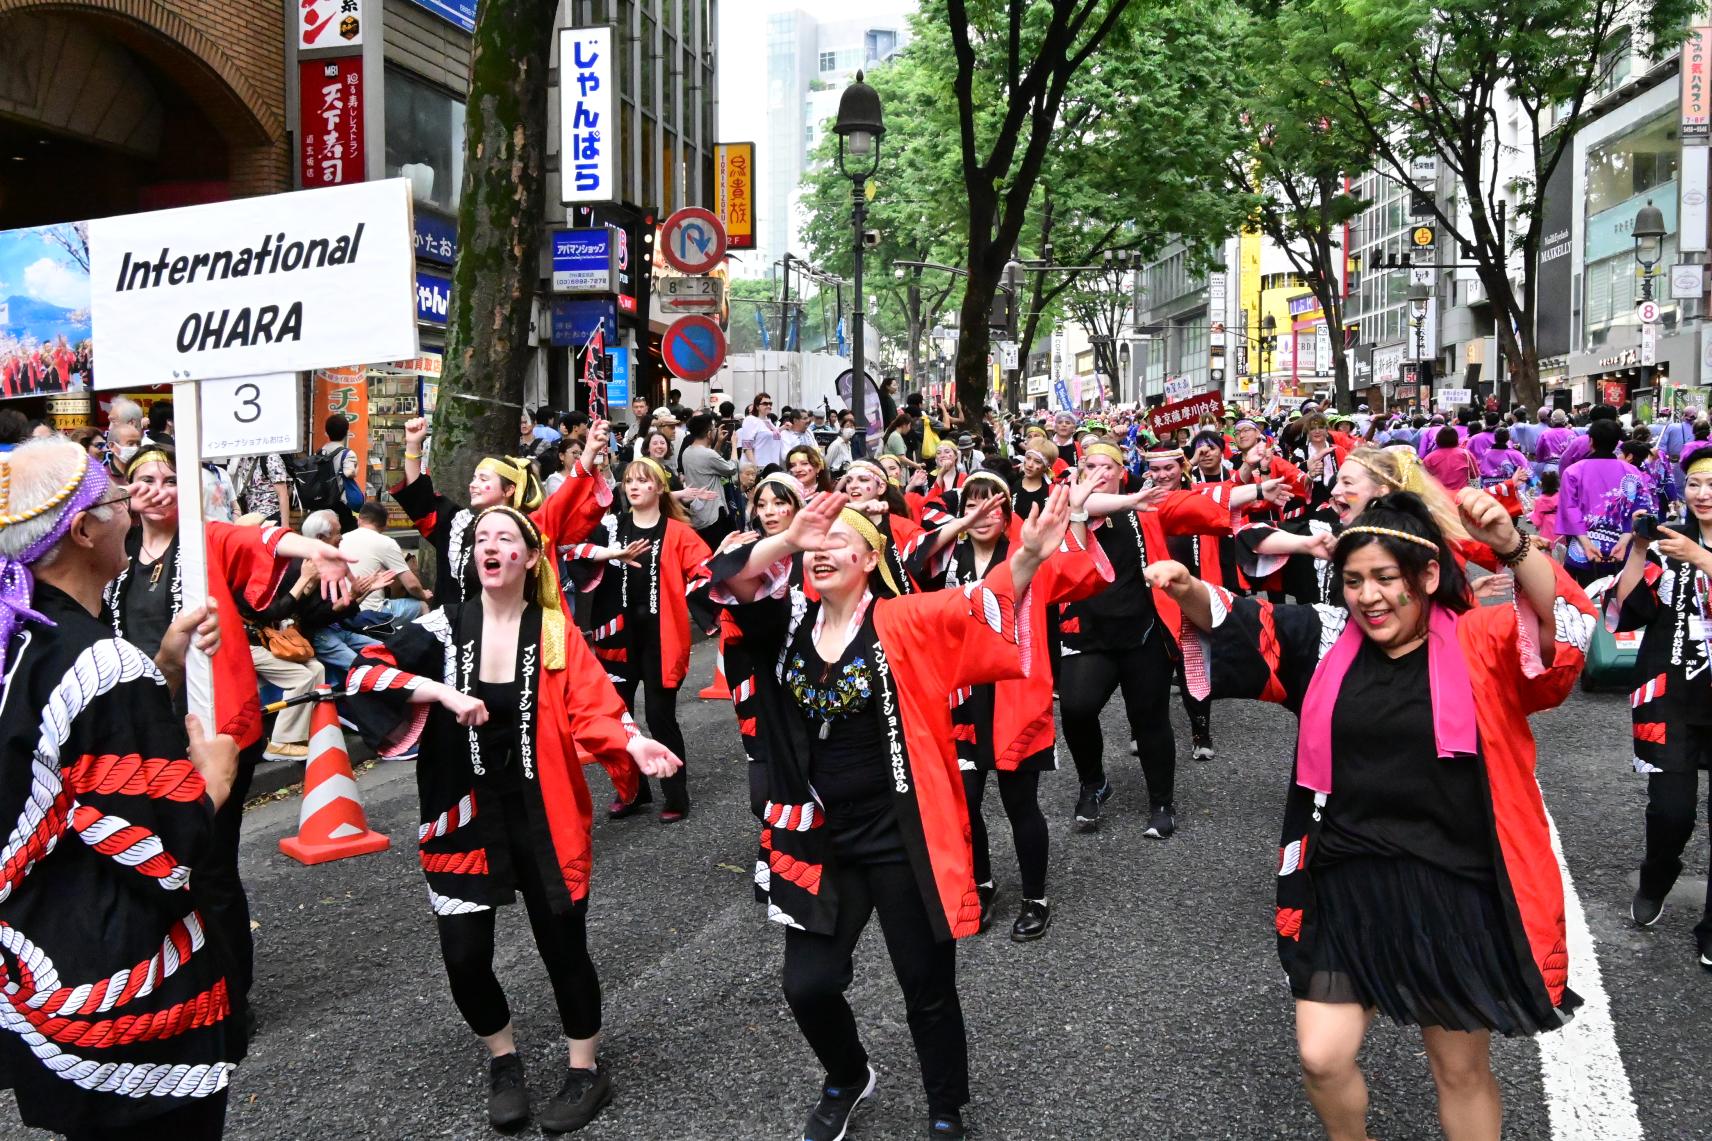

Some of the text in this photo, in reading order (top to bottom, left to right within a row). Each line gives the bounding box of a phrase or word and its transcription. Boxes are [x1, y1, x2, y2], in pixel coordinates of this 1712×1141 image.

[317, 82, 344, 183] 天下寿司
[573, 40, 600, 191] じゃんぱら
[116, 222, 366, 292] International
[414, 230, 457, 257] かたお
[557, 243, 606, 255] アパマンショップ
[176, 301, 303, 354] OHARA
[1643, 304, 1654, 319] 8
[233, 383, 262, 424] 3
[1153, 398, 1220, 429] 東京薩摩川内会
[207, 433, 292, 451] インターナショナルおはら
[518, 643, 537, 780] インターナショナルおはら
